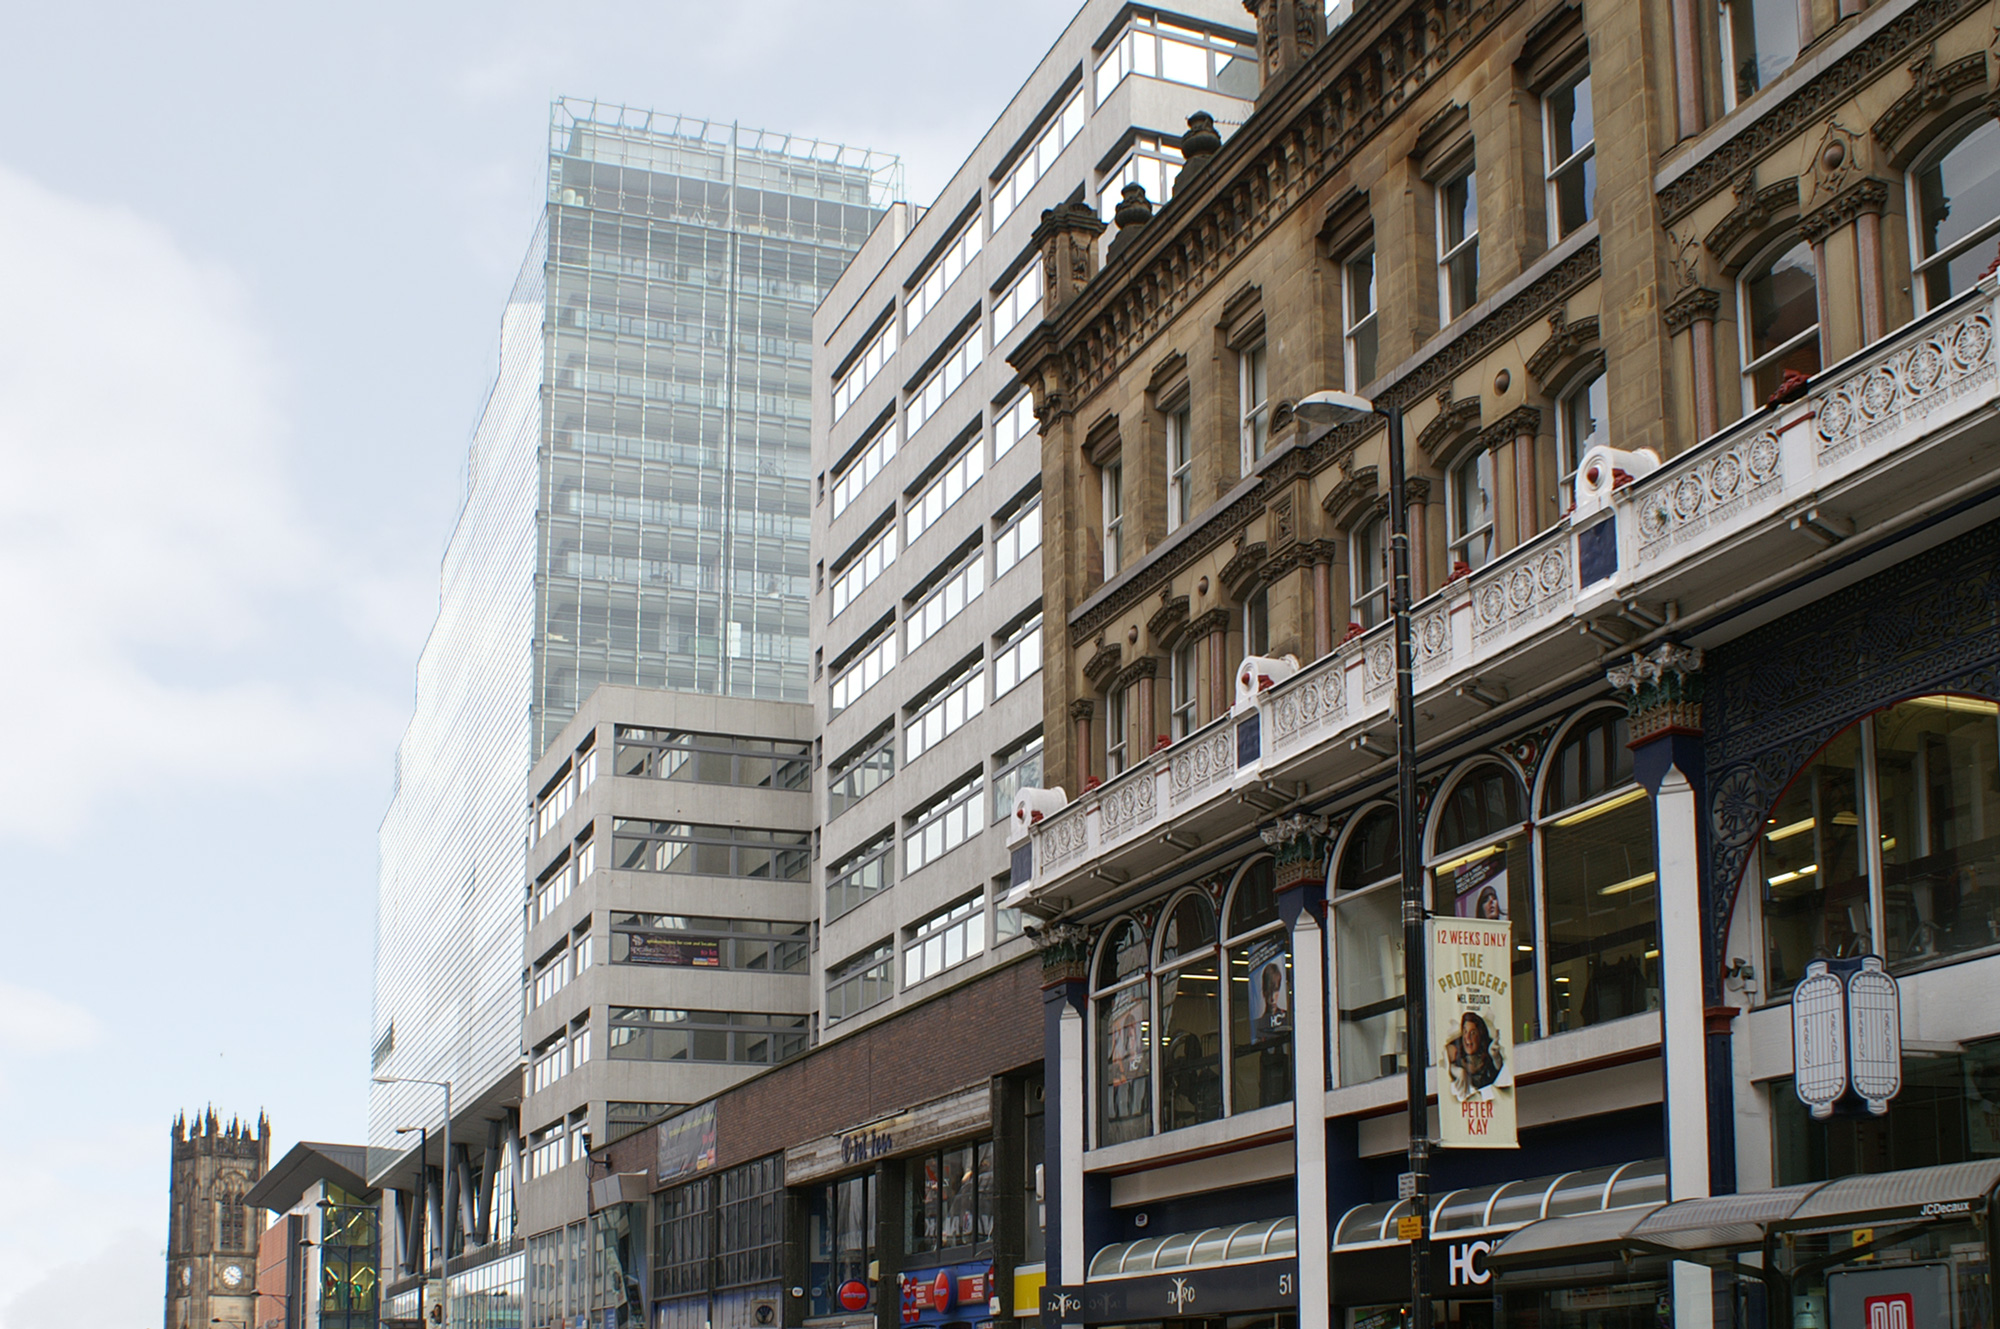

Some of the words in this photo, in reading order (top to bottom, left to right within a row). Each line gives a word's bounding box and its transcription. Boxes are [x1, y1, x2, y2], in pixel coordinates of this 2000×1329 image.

[1437, 929, 1447, 944] 12
[1450, 930, 1480, 946] WEEKS
[1483, 932, 1507, 947] ONLY
[1461, 952, 1483, 968] THE
[1438, 969, 1508, 995] PRODUCERS
[1462, 1101, 1493, 1118] PETER
[1468, 1119, 1488, 1135] KAY
[1920, 1202, 1970, 1216] JCDecaux
[1279, 1273, 1292, 1295] 51
[1167, 1277, 1196, 1314] INTRO
[1048, 1292, 1081, 1318] INTRO
